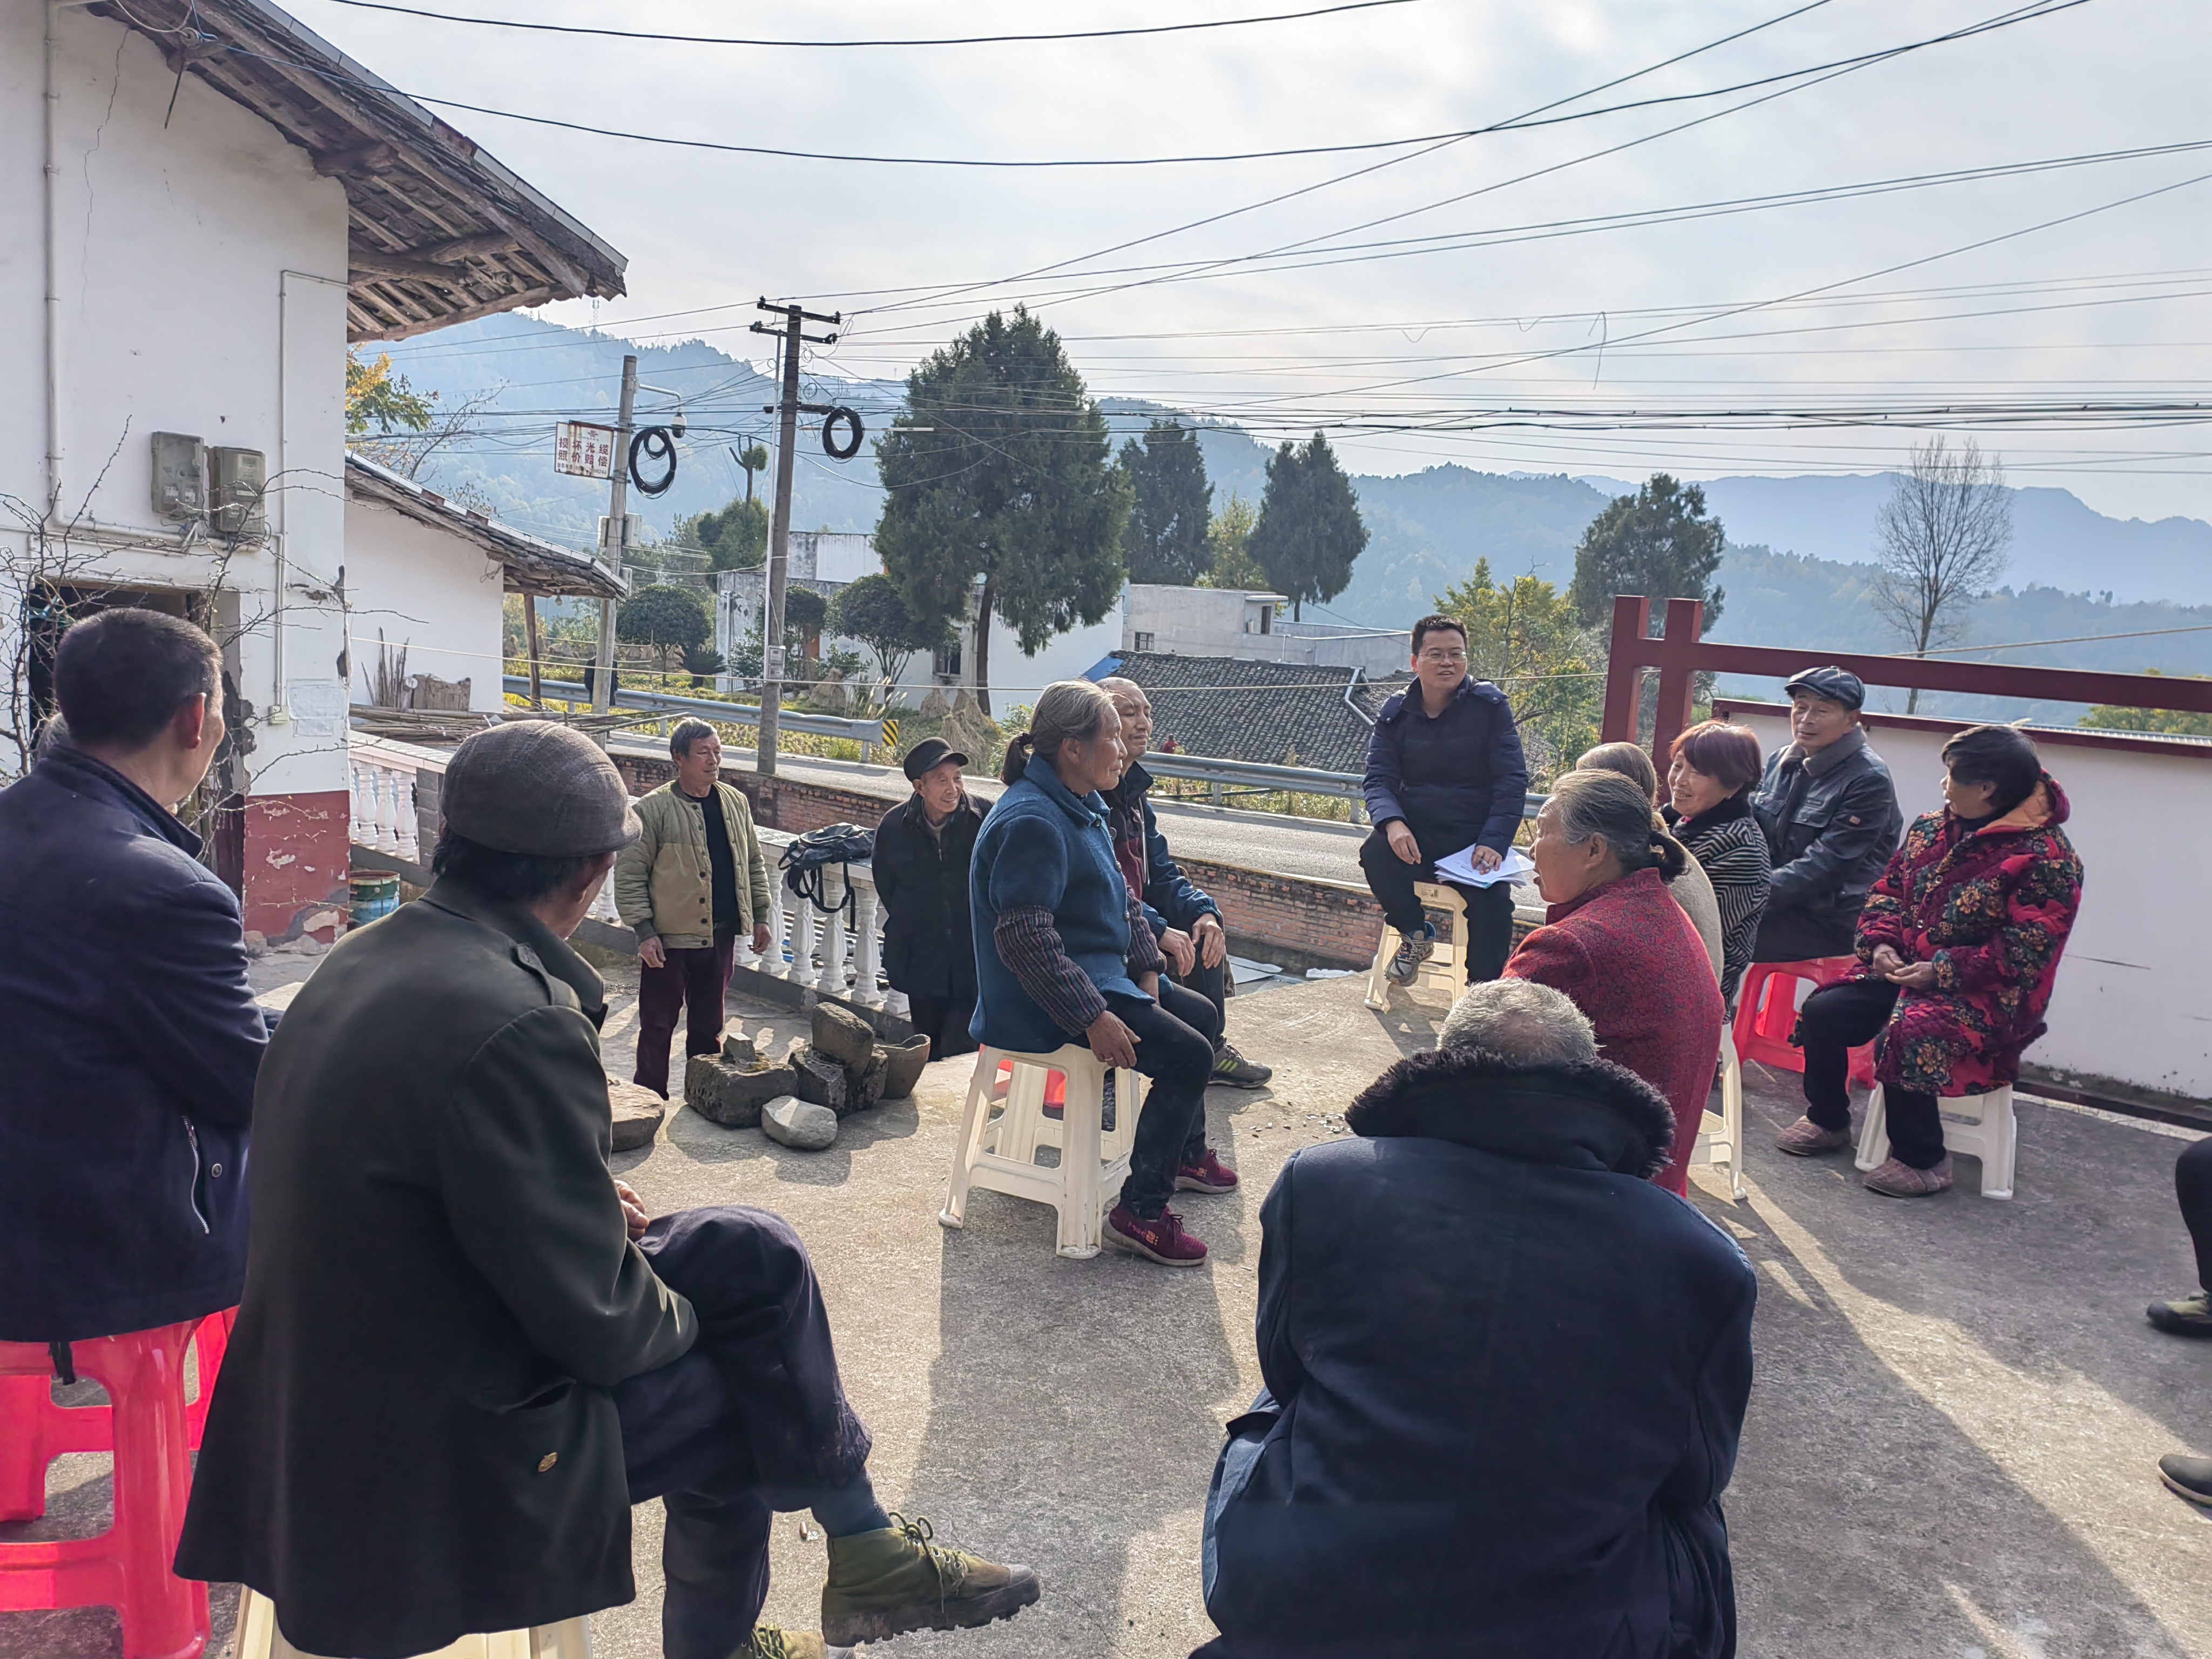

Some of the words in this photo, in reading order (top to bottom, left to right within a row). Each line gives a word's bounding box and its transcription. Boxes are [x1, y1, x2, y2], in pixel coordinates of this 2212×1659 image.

[558, 436, 609, 455] 损坏光缆
[558, 449, 608, 467] 照价赔偿
